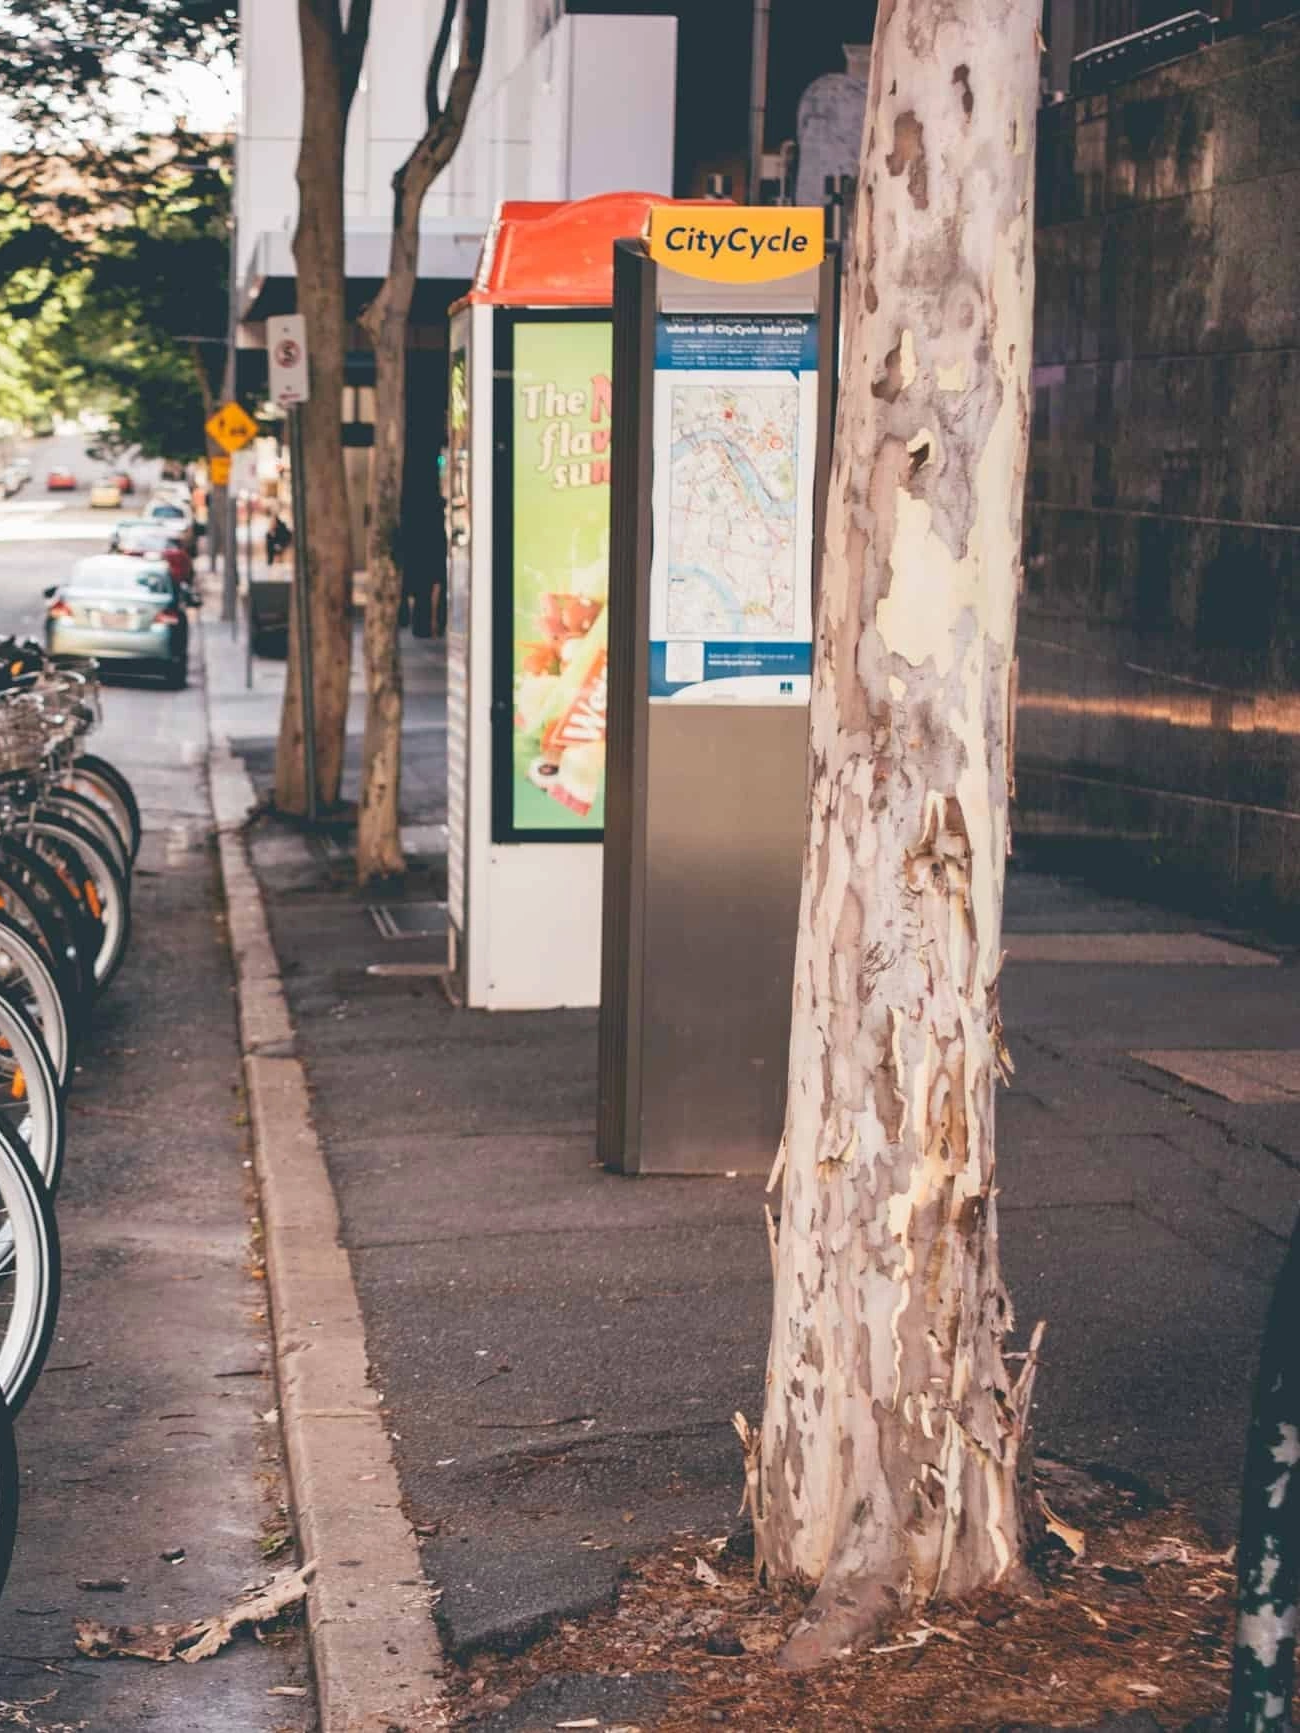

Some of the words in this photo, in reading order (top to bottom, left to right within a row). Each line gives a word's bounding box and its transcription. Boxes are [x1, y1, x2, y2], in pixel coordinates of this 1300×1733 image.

[665, 226, 809, 260] CityCycle
[698, 324, 714, 334] will
[716, 324, 760, 337] CityCycle
[783, 325, 809, 337] you?
[521, 381, 585, 420] The
